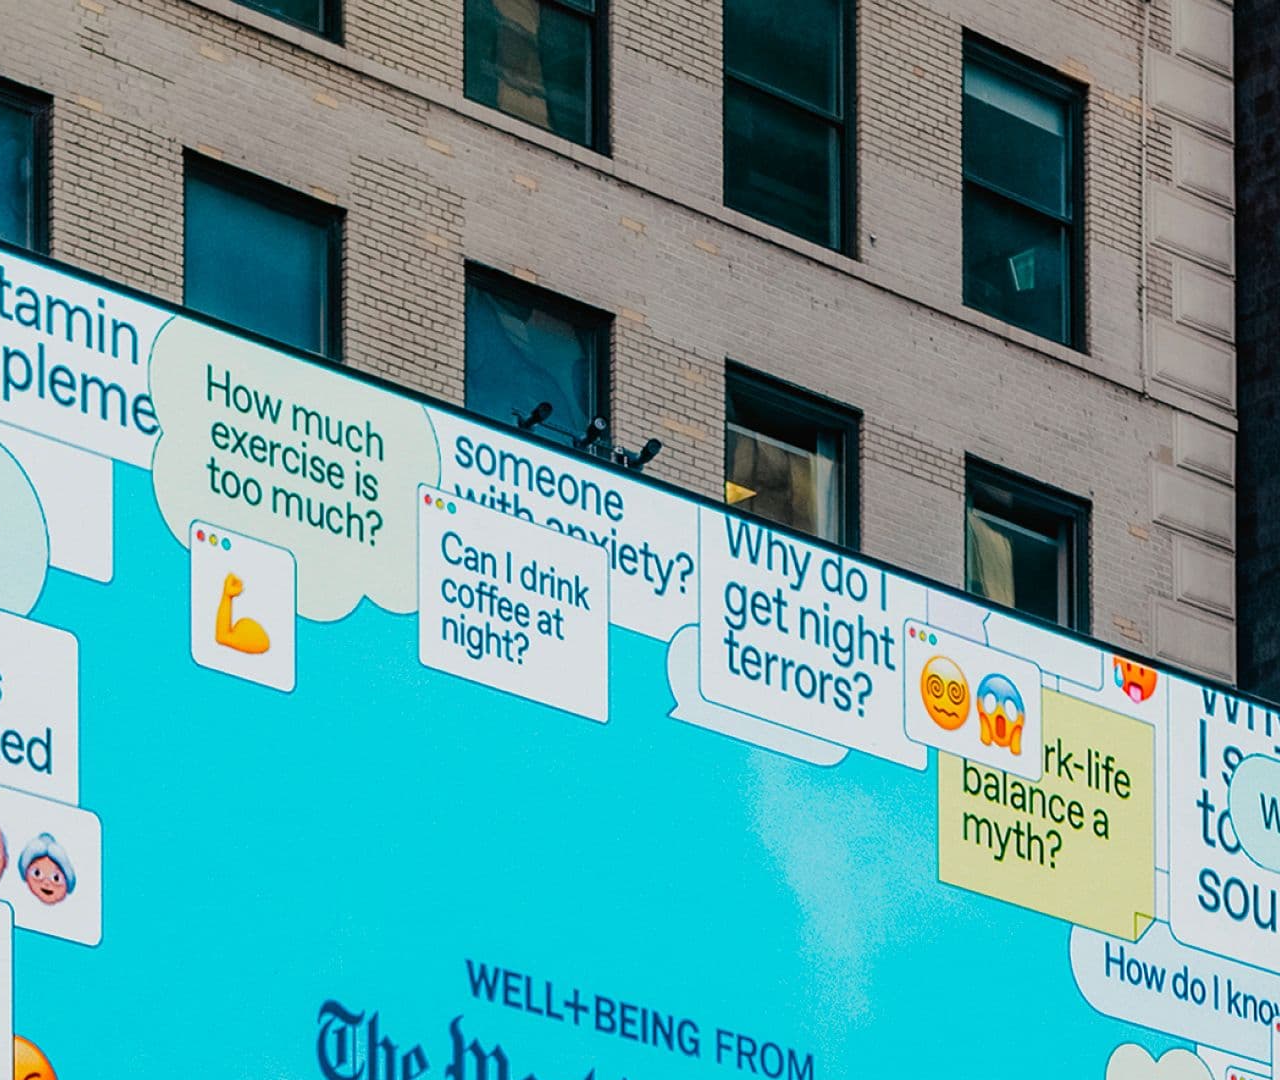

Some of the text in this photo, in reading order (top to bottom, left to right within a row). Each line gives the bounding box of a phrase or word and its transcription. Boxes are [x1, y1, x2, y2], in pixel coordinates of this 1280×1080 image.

[206, 364, 385, 463] How much
[206, 456, 384, 547] too much?
[211, 422, 379, 503] exercise is
[455, 434, 624, 522] someone
[441, 530, 591, 612] Can I drink
[724, 515, 888, 612] Why do I
[441, 573, 566, 642] coffee at
[441, 613, 531, 666] night?
[724, 580, 897, 673] get night
[724, 629, 874, 720] terrors?
[1043, 737, 1132, 800] rk-life
[1199, 717, 1207, 779] I
[962, 755, 1110, 840] balance a
[1196, 788, 1241, 855] to
[962, 811, 1063, 869] myth?
[465, 958, 701, 1058] WELL+BEING
[1104, 941, 1167, 993] How
[1172, 964, 1207, 1004] do
[1213, 974, 1220, 1010] I
